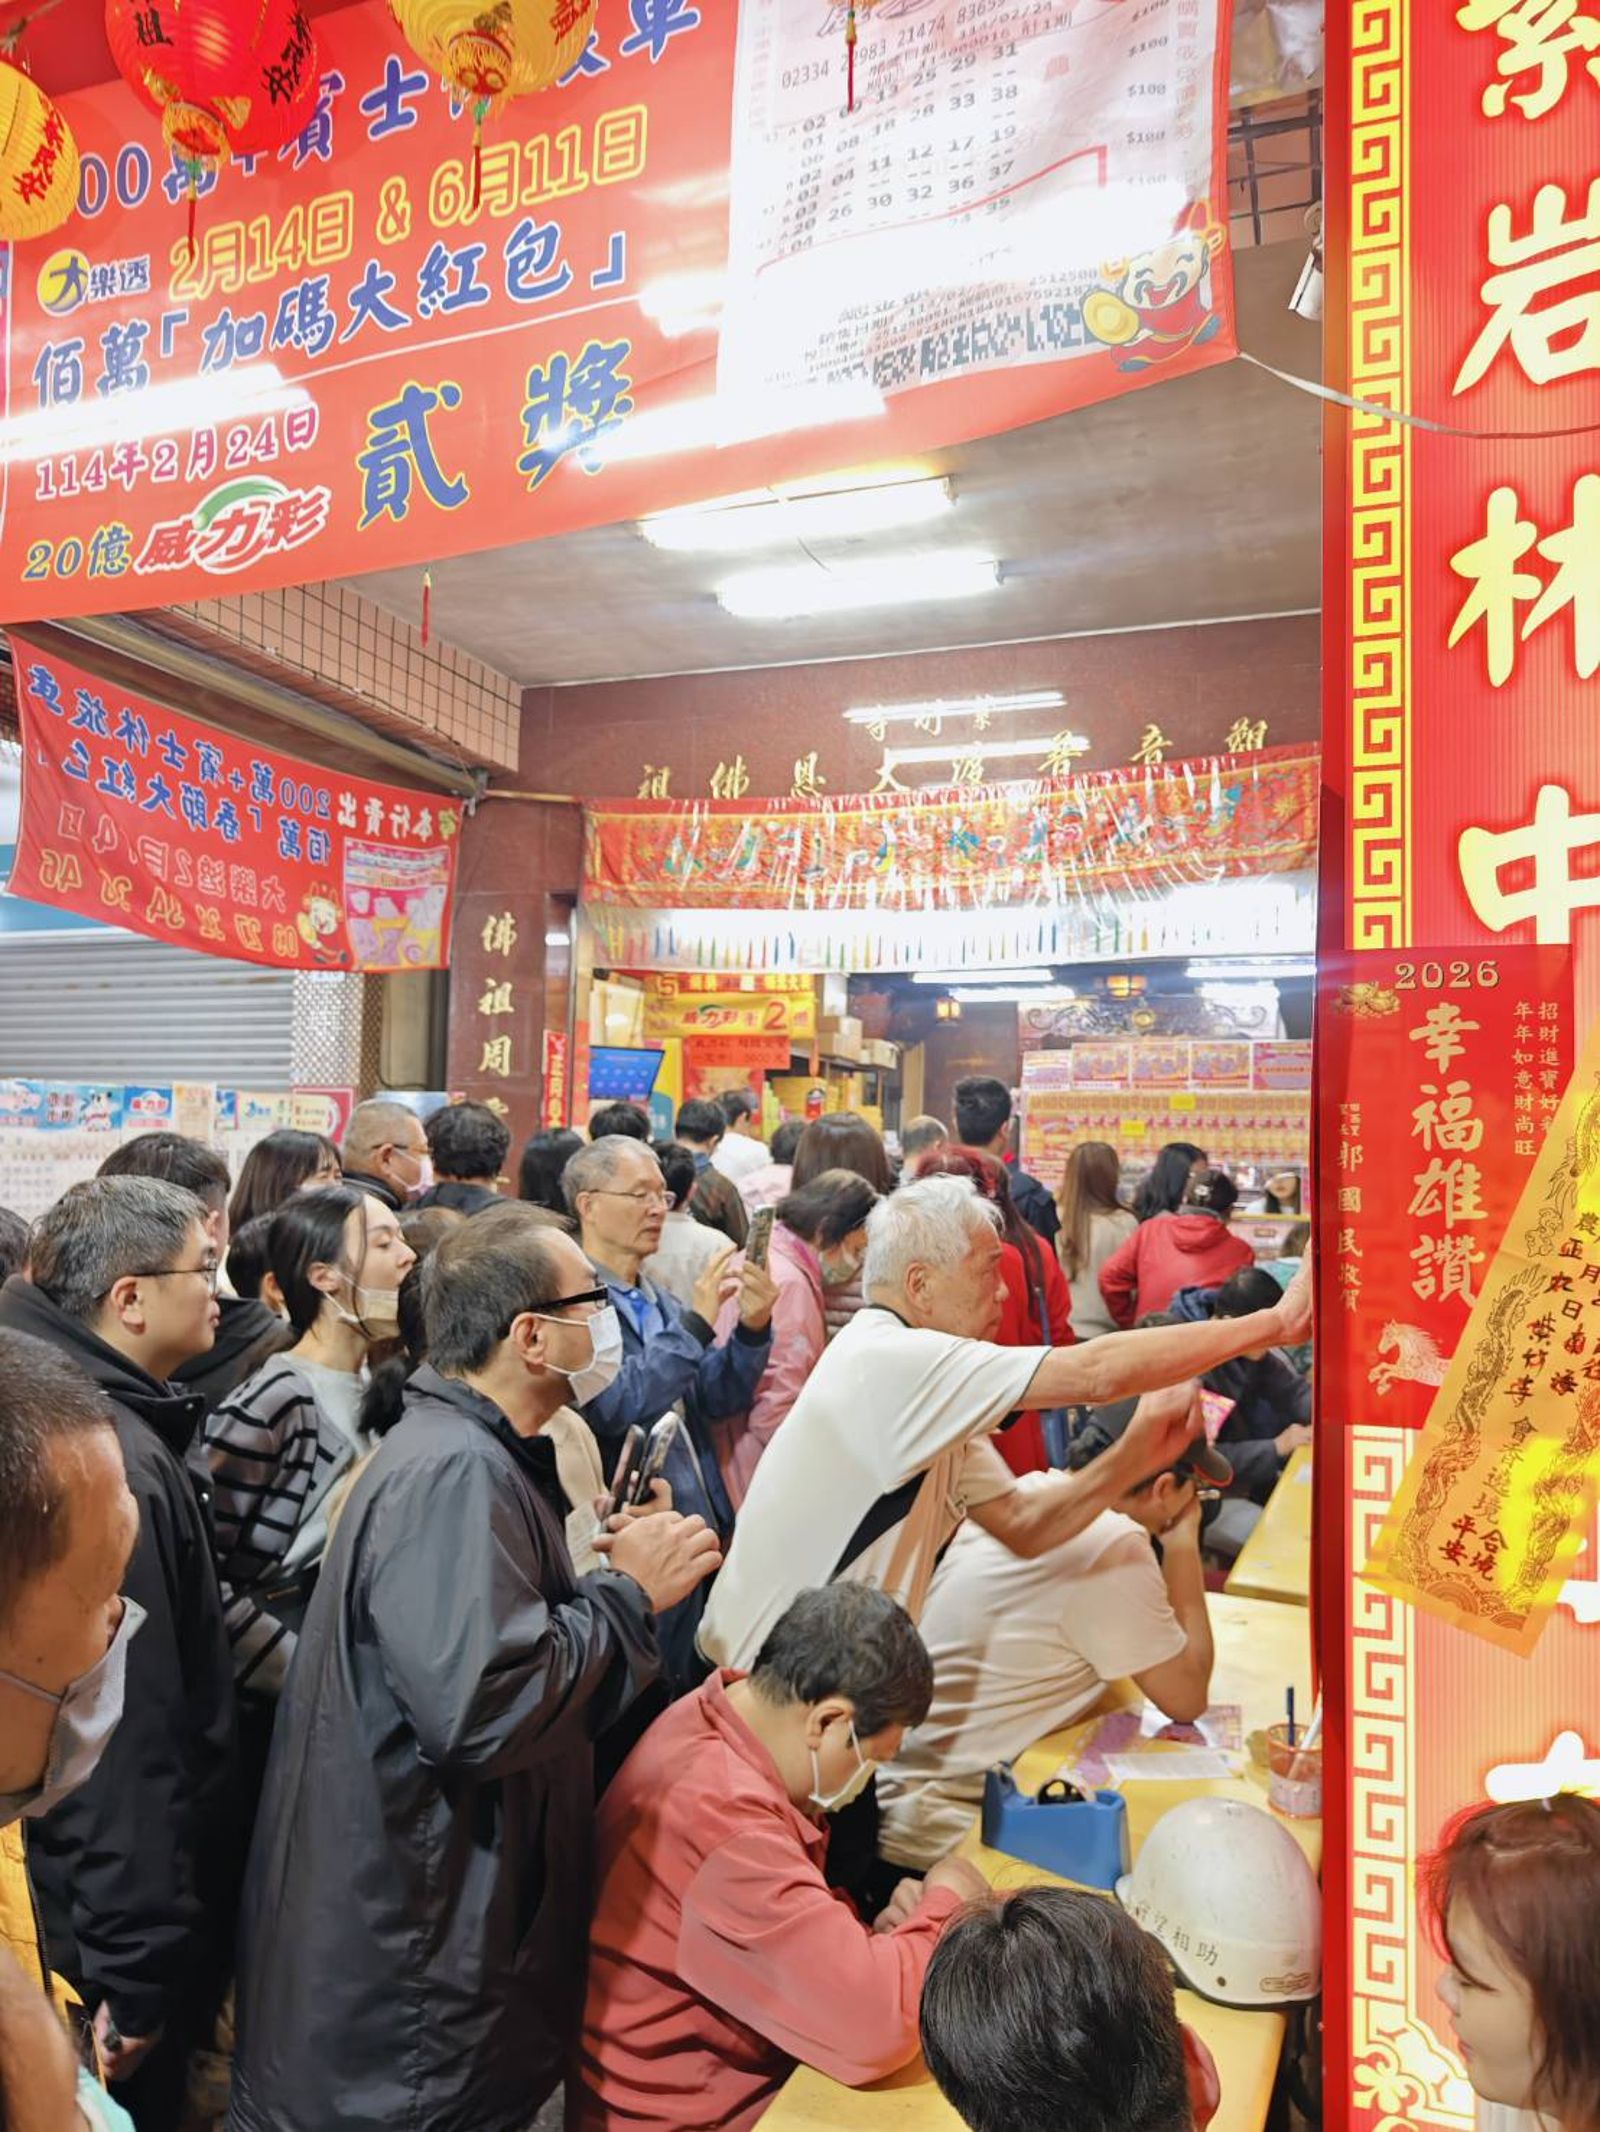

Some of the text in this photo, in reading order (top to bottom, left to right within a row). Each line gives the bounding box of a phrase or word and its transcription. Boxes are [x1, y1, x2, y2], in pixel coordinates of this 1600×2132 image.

[781, 59, 830, 90] 02334
[170, 105, 648, 300] 2月14日 & 6月11日
[35, 405, 319, 500] 114年2月24日
[22, 520, 133, 581] 20億
[1394, 959, 1501, 991] 2026
[1513, 1001, 1537, 1156] 年年如意財尚旺
[1407, 1002, 1489, 1308] 幸福雄讚
